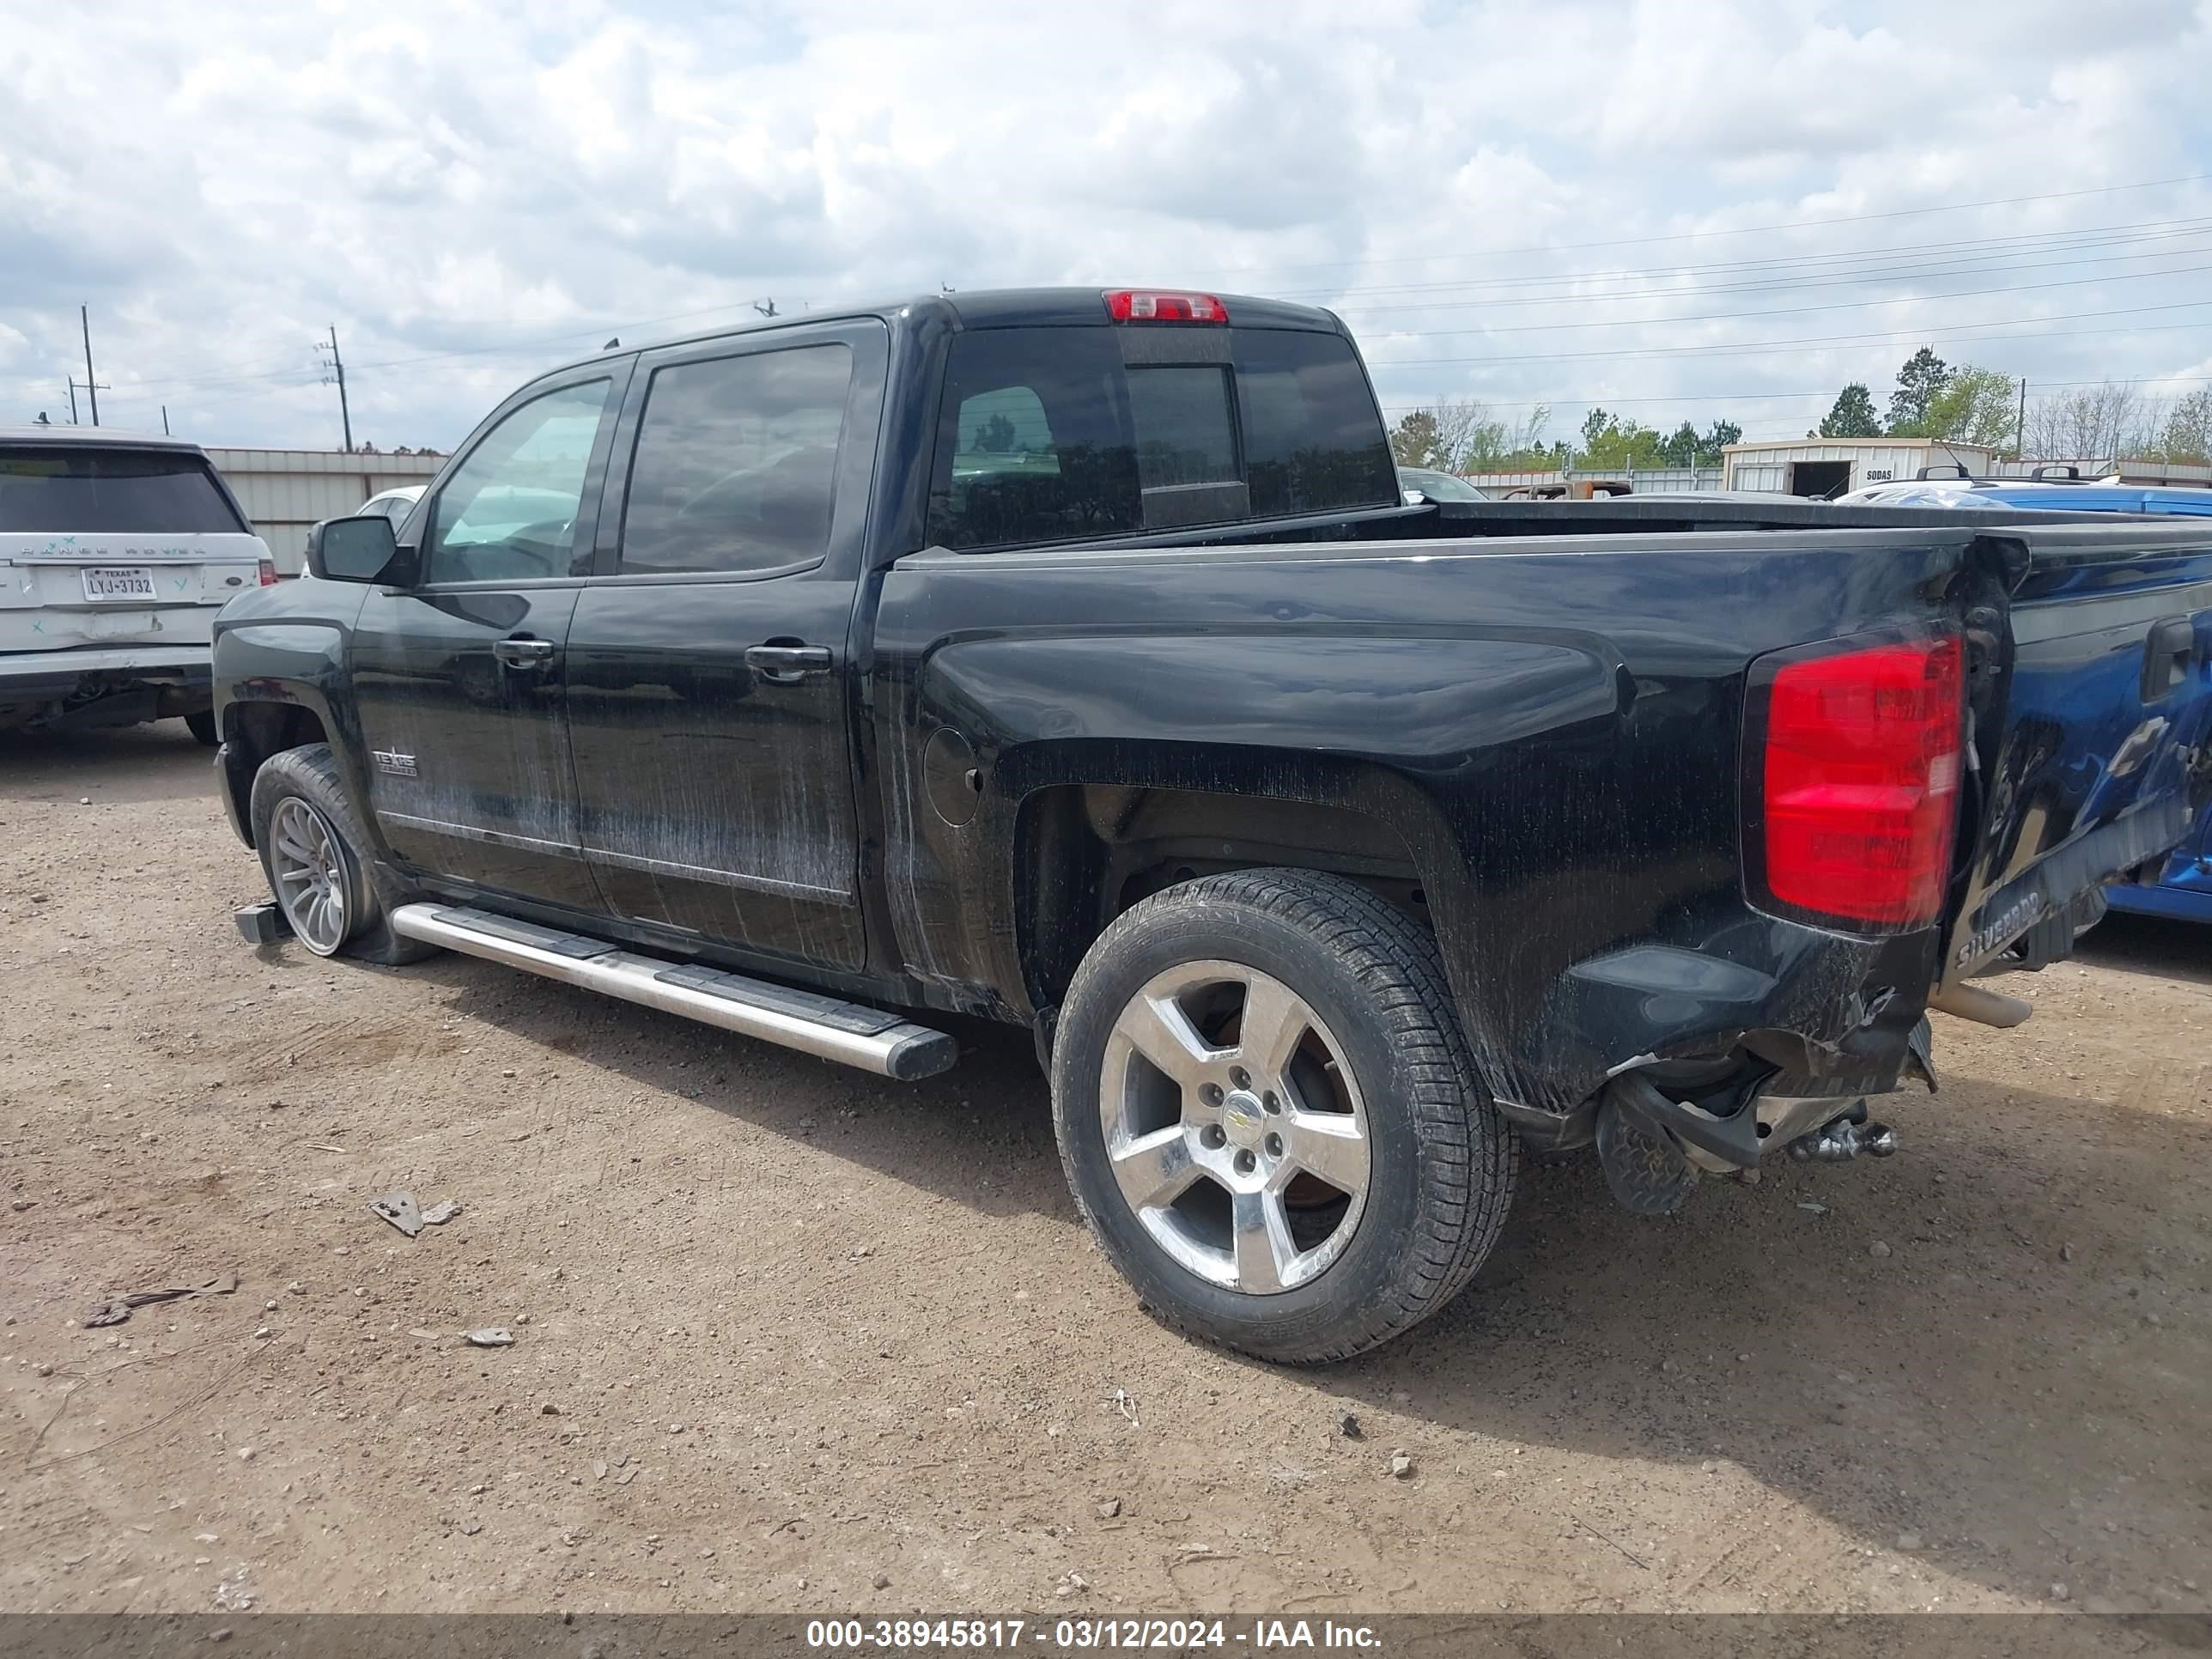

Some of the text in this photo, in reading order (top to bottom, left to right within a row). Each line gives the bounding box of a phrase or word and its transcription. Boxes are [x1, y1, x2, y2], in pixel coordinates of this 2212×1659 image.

[1867, 470, 1892, 480] SODAS
[89, 579, 152, 594] LYJ-3732
[371, 746, 416, 767] TEXAS
[1956, 891, 2039, 969] SILVERADO
